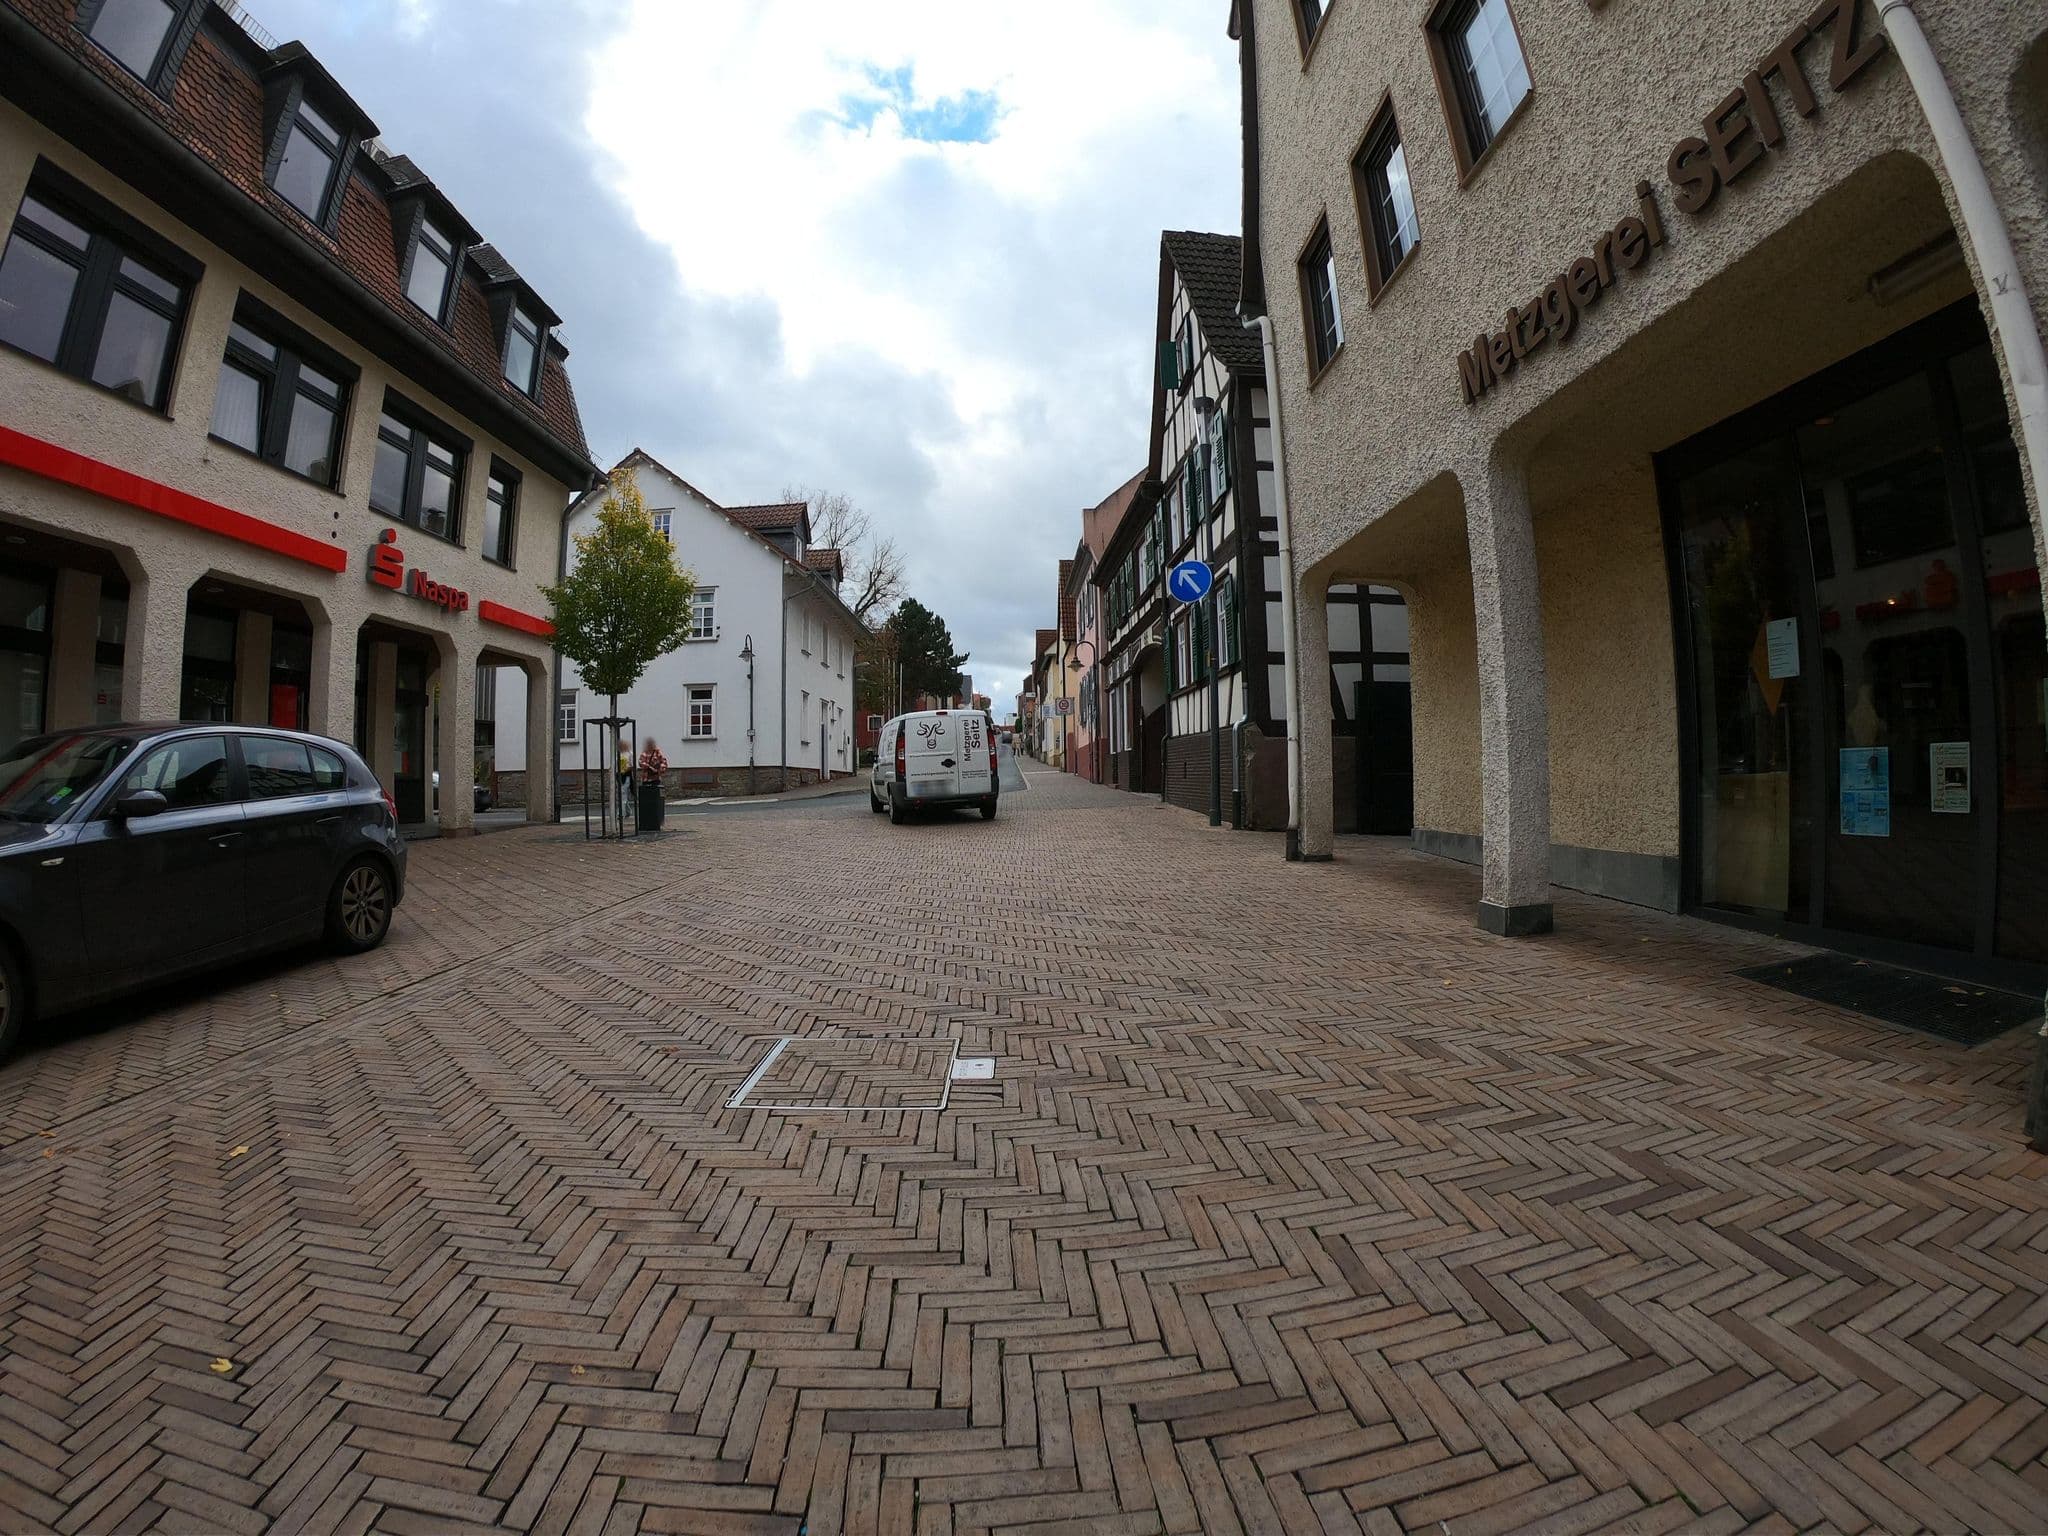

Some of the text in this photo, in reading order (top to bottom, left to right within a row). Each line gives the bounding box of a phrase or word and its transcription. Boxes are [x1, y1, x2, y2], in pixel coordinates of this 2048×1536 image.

[1457, 0, 1887, 404] Metzgerei SEITZ
[407, 568, 469, 613] Naspa
[961, 720, 972, 762] Metzgerei
[971, 719, 981, 749] Seitz
